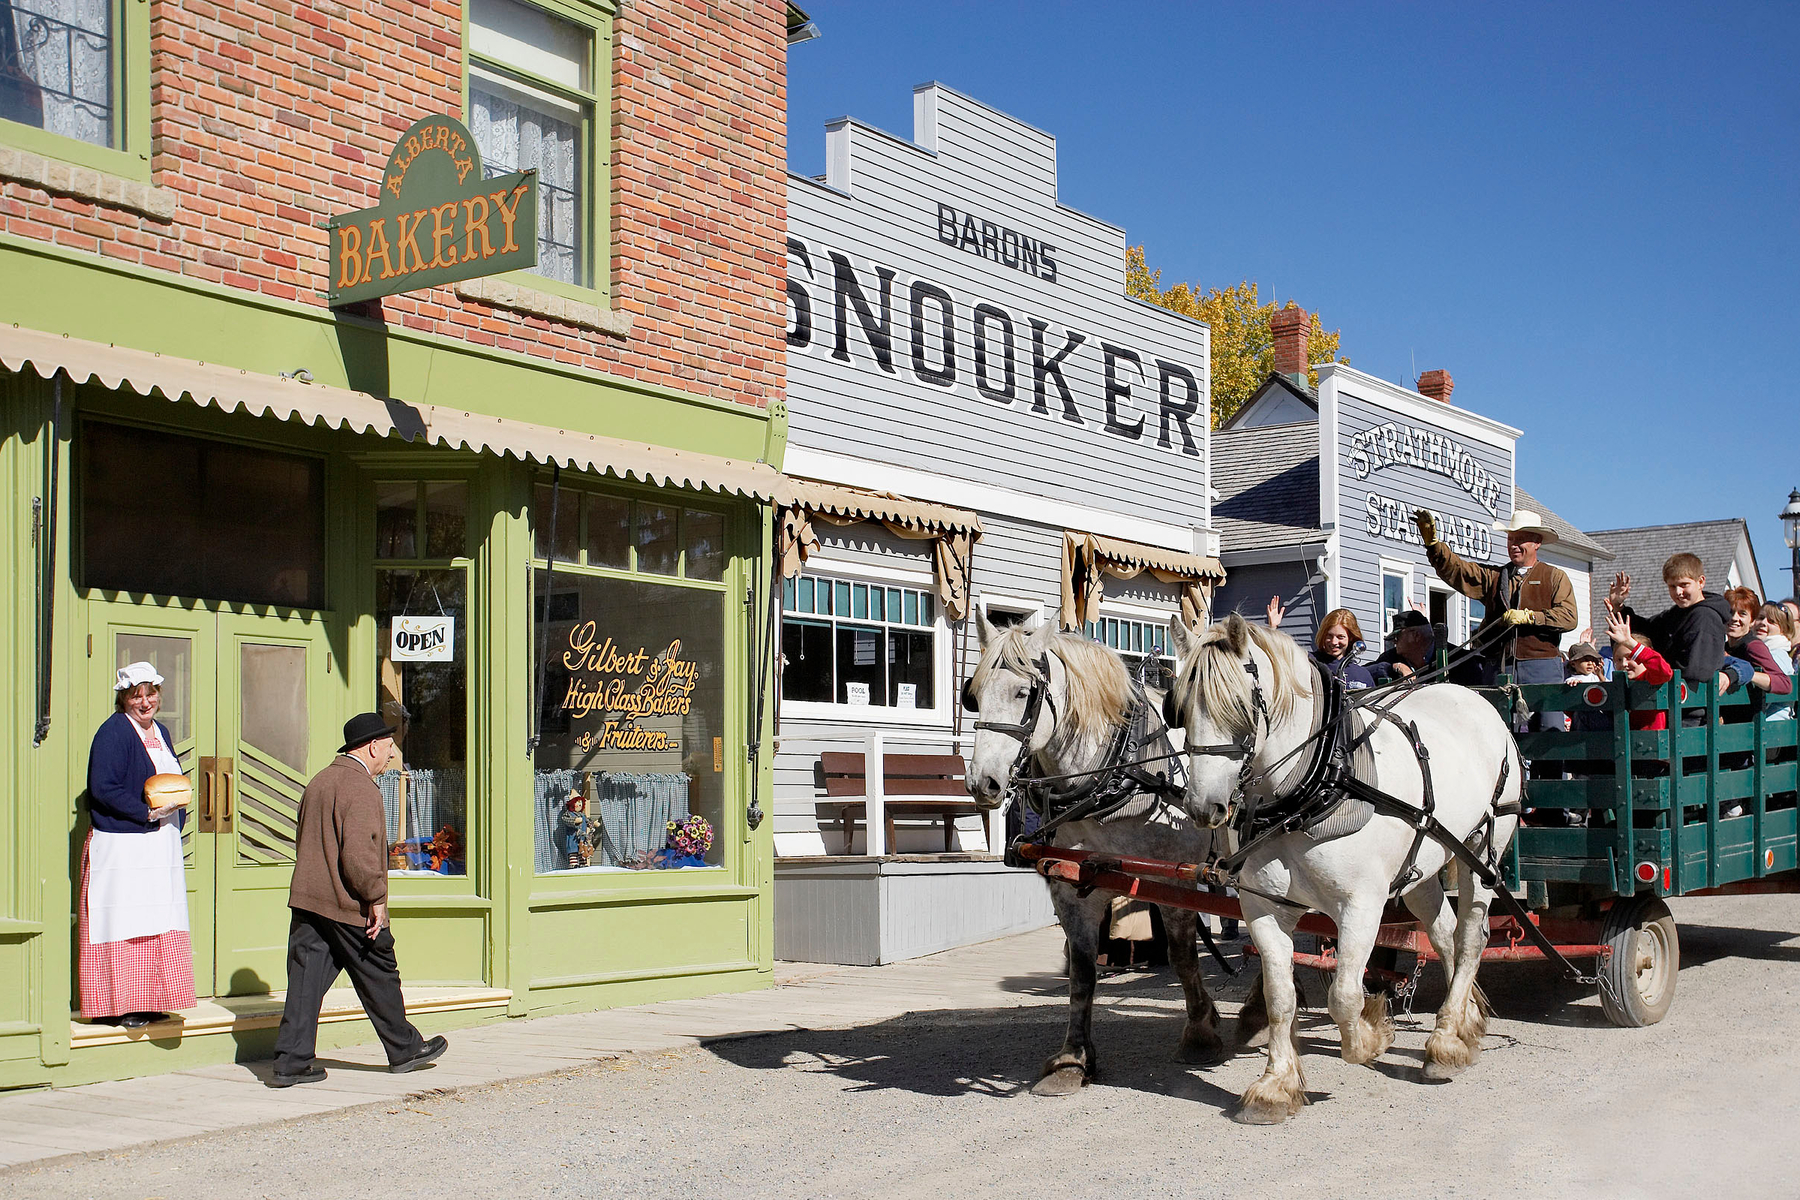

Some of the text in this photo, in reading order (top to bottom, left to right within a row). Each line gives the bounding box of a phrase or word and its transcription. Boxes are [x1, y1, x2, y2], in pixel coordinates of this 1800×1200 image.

[386, 124, 474, 198] ALBERTA
[337, 185, 529, 289] BAKERY
[937, 202, 1058, 284] BARONS
[1347, 421, 1501, 519] STRATHMORE
[396, 627, 445, 651] OPEN
[563, 620, 650, 675] Gilbert
[625, 683, 692, 720] Bakers
